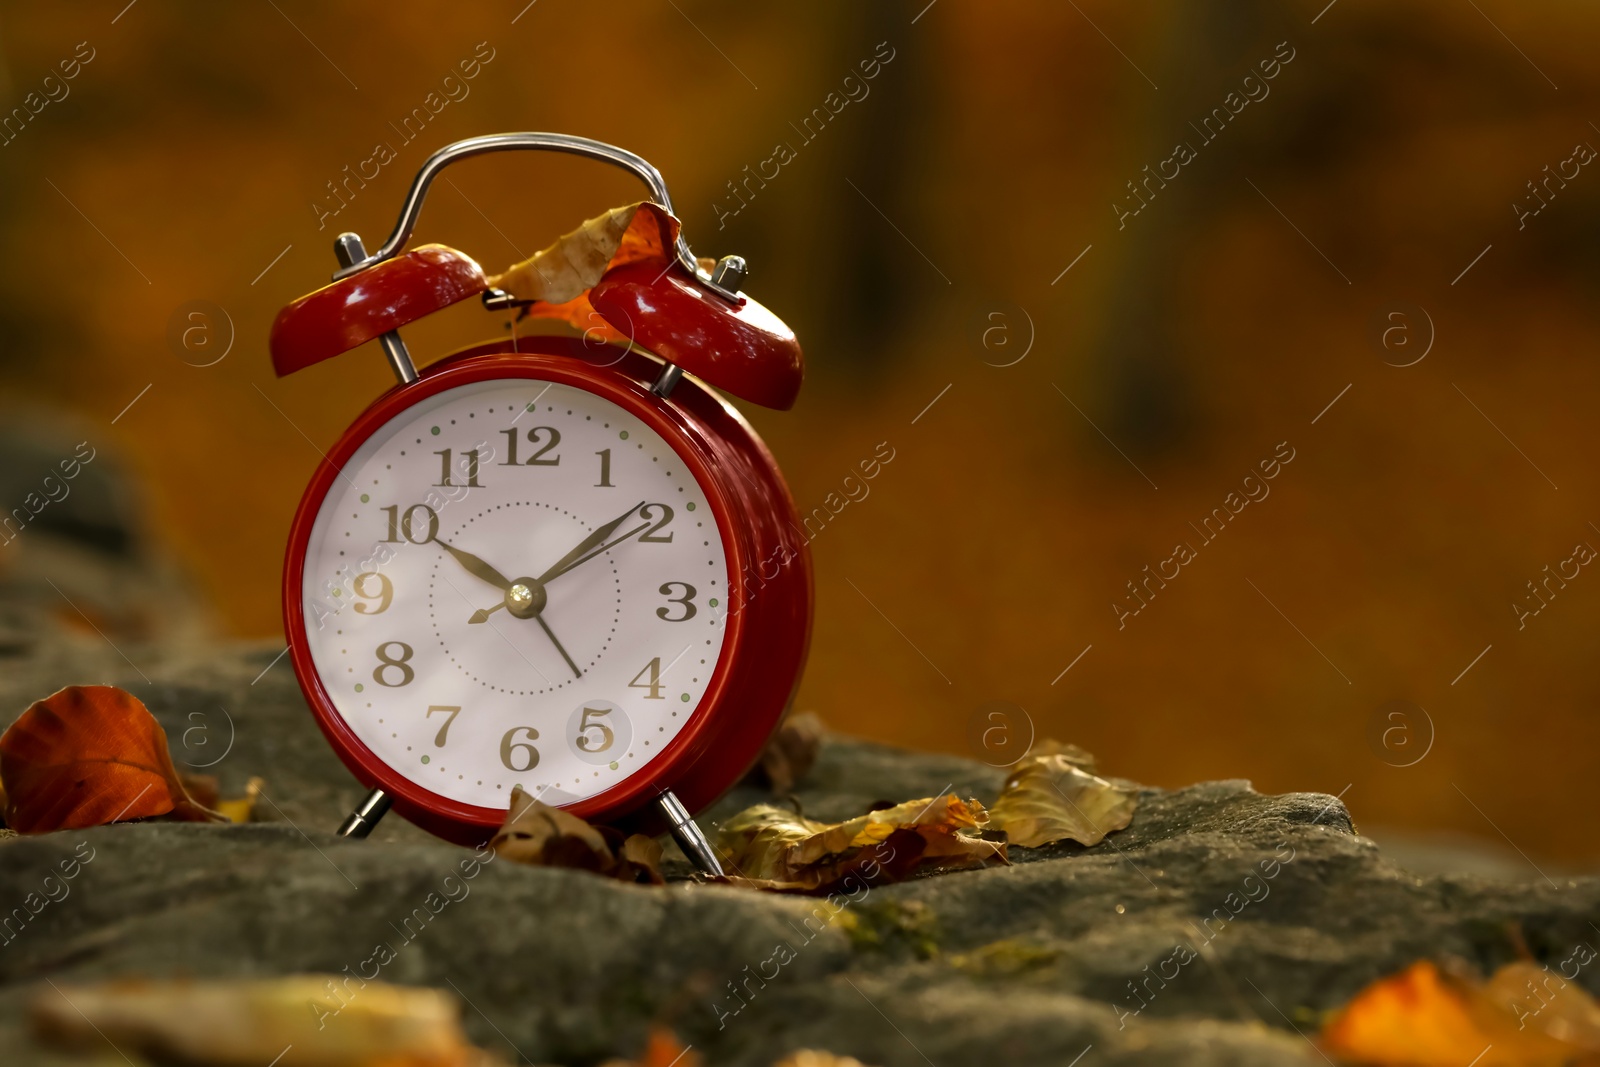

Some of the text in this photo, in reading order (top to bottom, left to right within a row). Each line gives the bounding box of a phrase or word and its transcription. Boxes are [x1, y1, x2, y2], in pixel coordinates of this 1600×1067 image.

[498, 426, 561, 467] 12
[432, 449, 486, 488] 11
[594, 449, 616, 487] 1
[378, 504, 439, 544] 10
[638, 503, 674, 543] 2
[353, 571, 393, 615] 9
[656, 581, 697, 622] 3
[372, 641, 414, 687] 8
[628, 657, 666, 699] 4
[426, 706, 461, 747] 7
[576, 707, 614, 753] 5
[499, 726, 540, 771] 6
